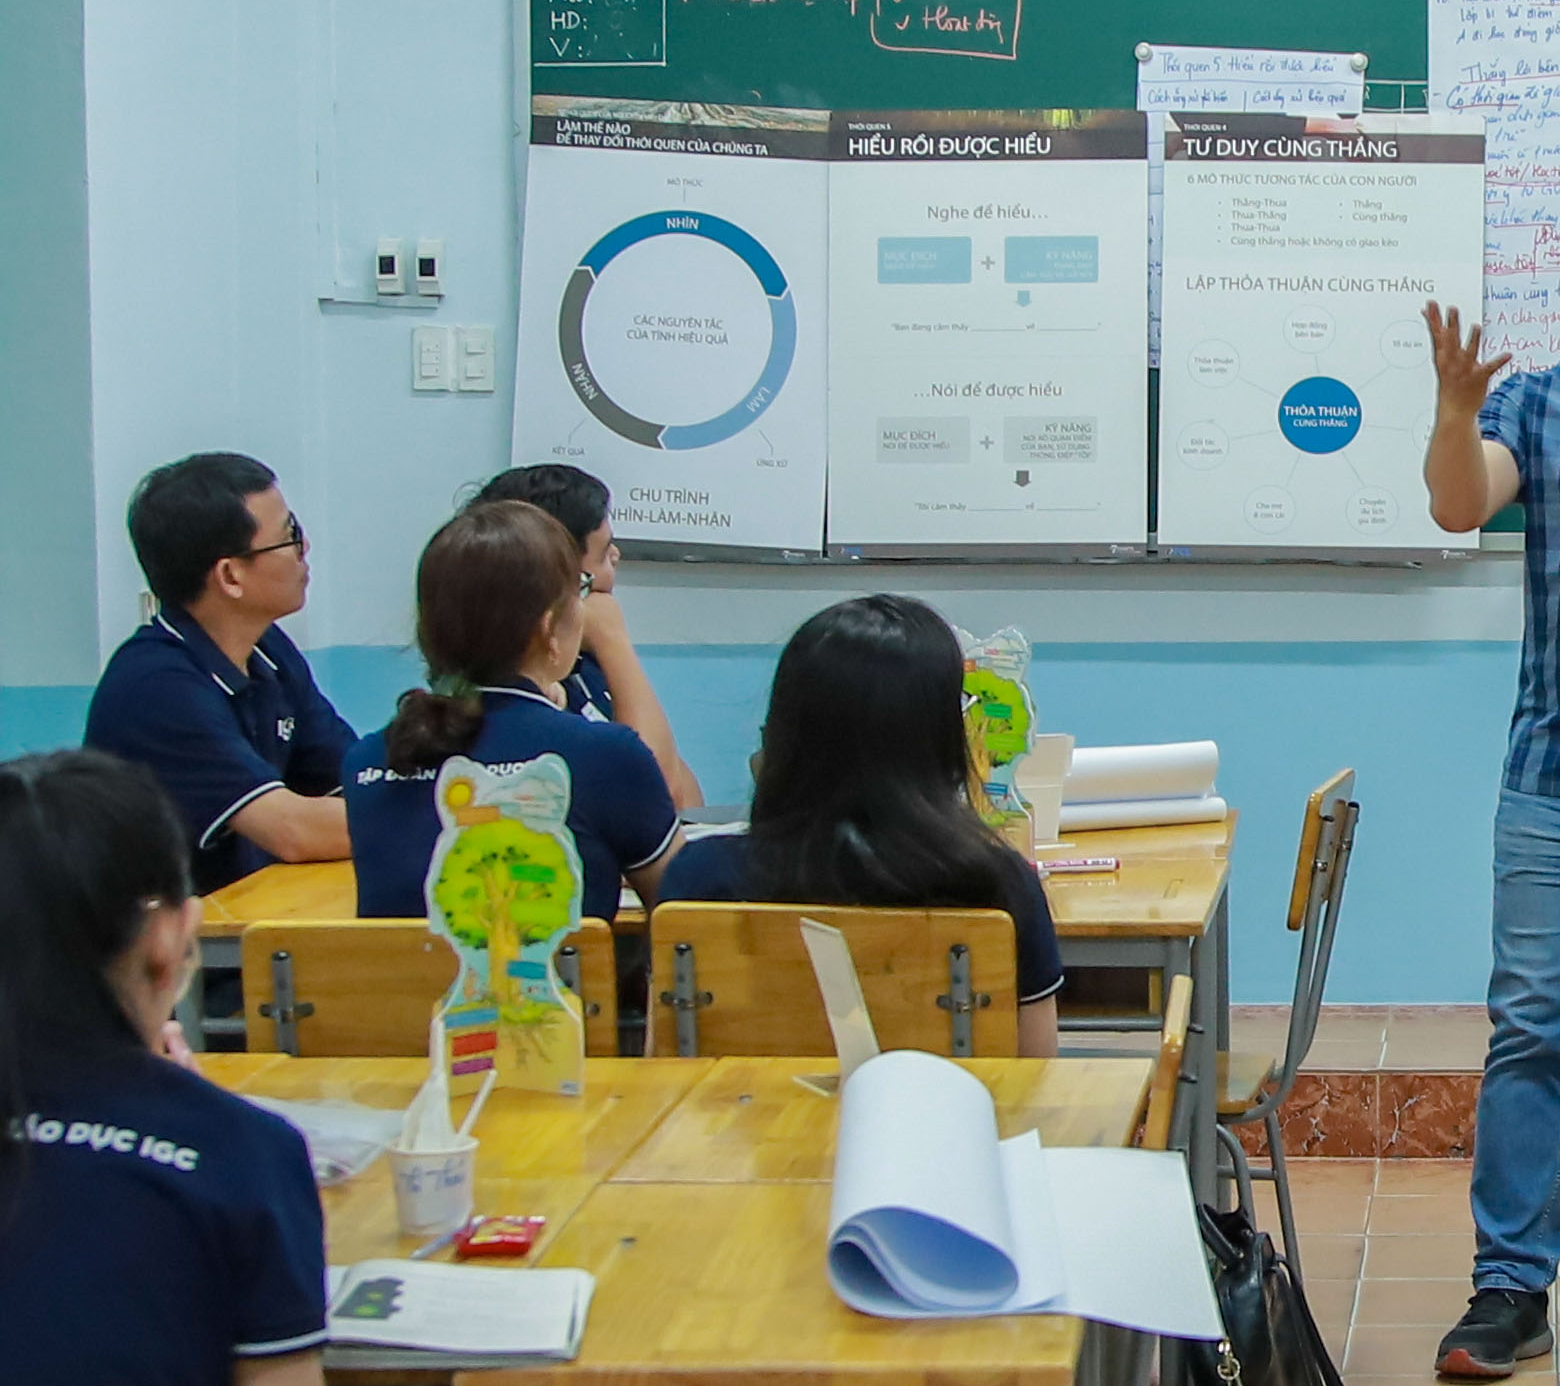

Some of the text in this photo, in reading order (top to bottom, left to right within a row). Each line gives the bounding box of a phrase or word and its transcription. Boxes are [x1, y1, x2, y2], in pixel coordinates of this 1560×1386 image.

[557, 120, 630, 135] LÀM THẾ NÀO
[556, 132, 768, 155] ĐỂ THAY ĐỔI THÓI QUEN CỦA CHÚNG TA
[848, 131, 1051, 158] HIỂU RỒI ĐƯỢC HIỂU
[1183, 136, 1398, 158] TƯ DUY CÙNG THẮNG
[1197, 173, 1218, 185] MÔ
[1222, 172, 1250, 185] THỨC
[1254, 173, 1296, 186] TƯƠNG
[1298, 173, 1321, 186] TÁC
[1323, 173, 1347, 186] CỦA
[1349, 176, 1375, 186] CON
[1378, 173, 1417, 187] NGƯỜI
[927, 205, 969, 222] Nghe
[973, 203, 993, 219] để
[666, 216, 699, 230] NHÌN
[1186, 273, 1435, 294] LẬP THỎA THUẬN CÙNG THẮNG
[962, 381, 982, 397] để
[985, 383, 1024, 399] được
[1029, 380, 1062, 397] hiểu
[1283, 404, 1358, 419] THỎA THUẬN
[629, 487, 710, 505] CHU TRÌNH
[65, 1121, 138, 1151] DỤC
[139, 1136, 200, 1172] IGC
